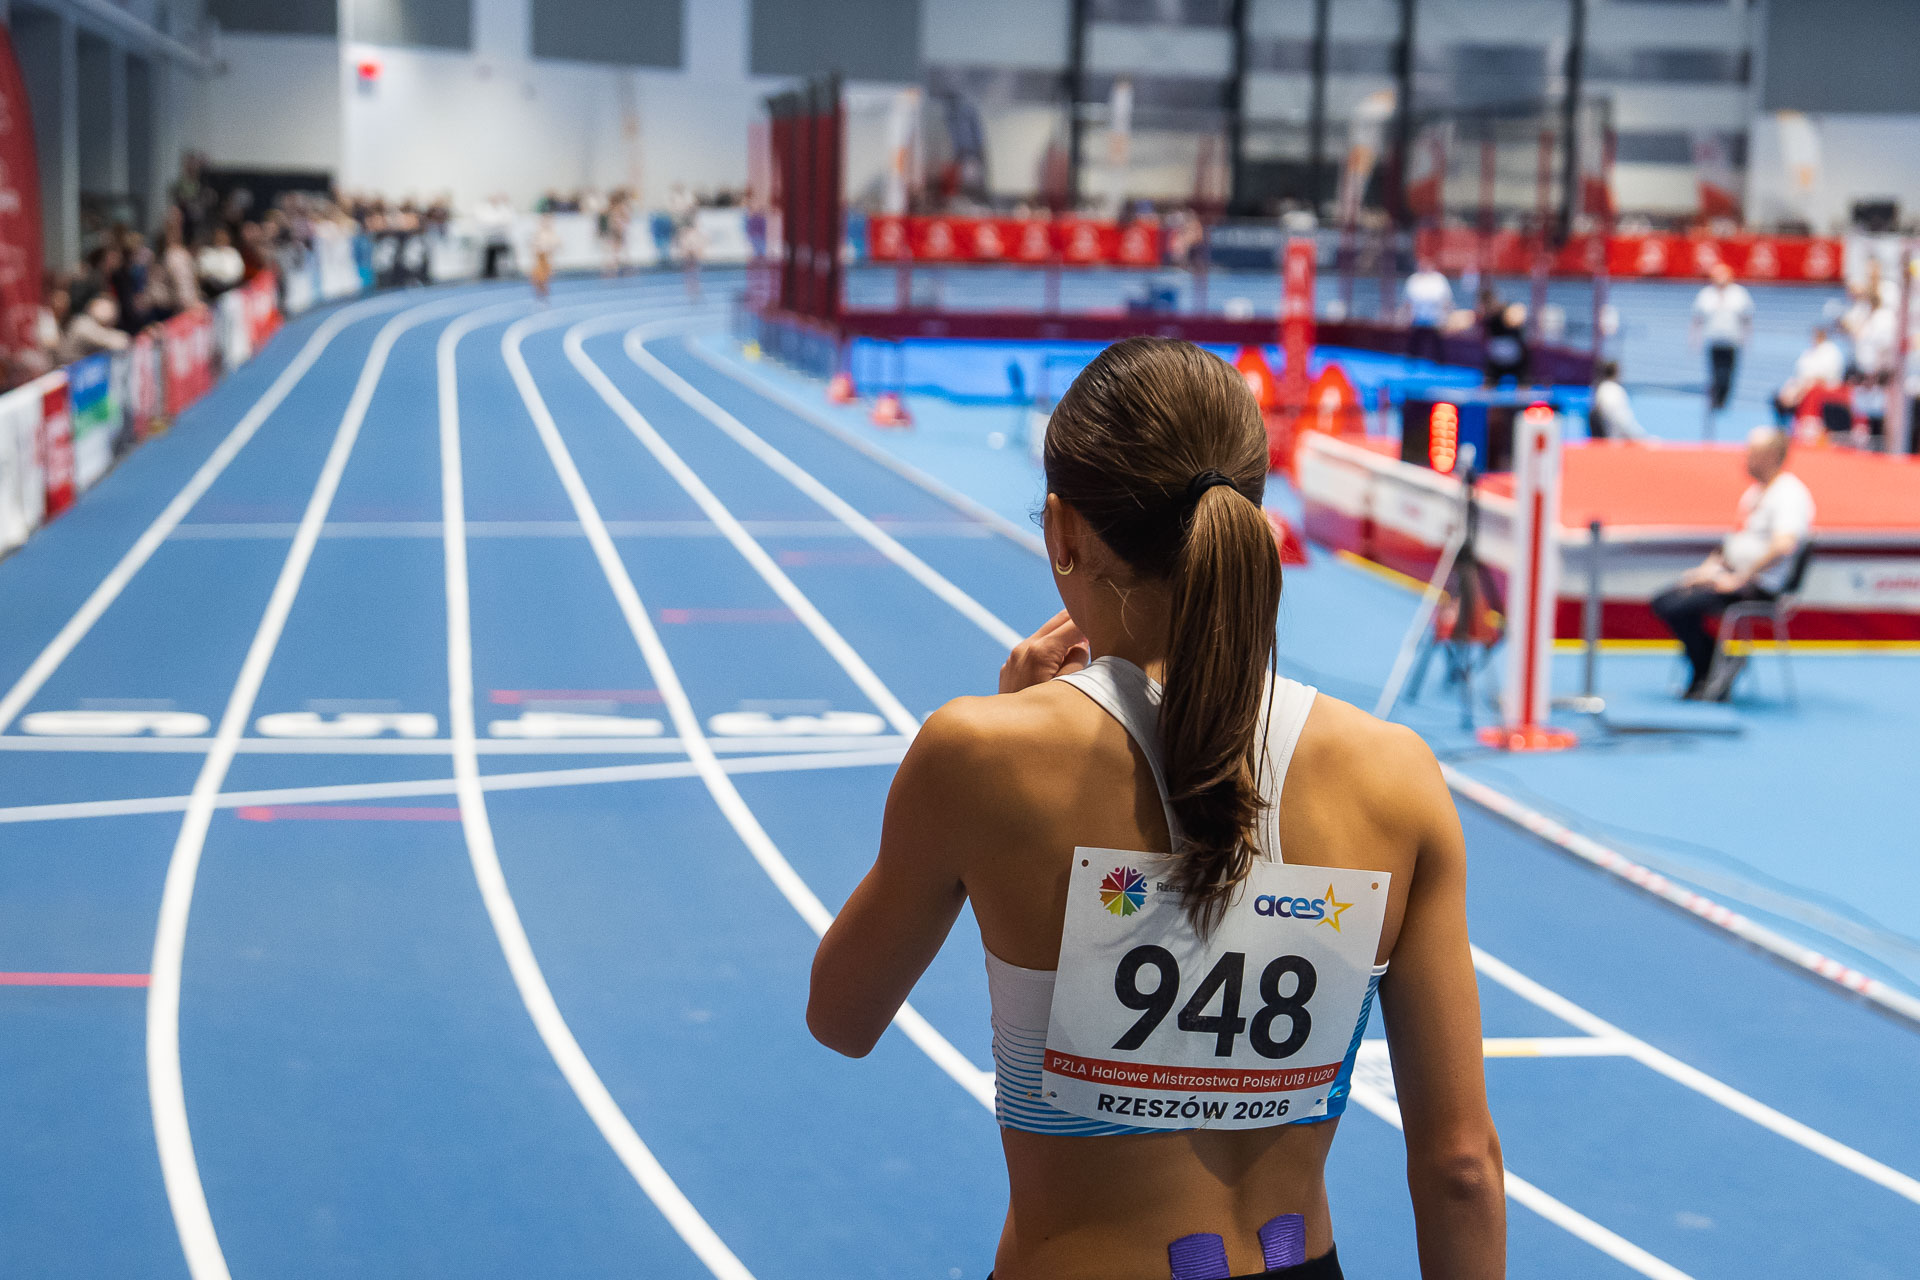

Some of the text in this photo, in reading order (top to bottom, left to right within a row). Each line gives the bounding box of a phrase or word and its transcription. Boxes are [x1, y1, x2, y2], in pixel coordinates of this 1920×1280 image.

[1254, 894, 1326, 920] aces
[1110, 944, 1318, 1060] 948
[1053, 1057, 1335, 1088] PZLA Halowe Mistrzostwa Polski U18 i U20
[1097, 1093, 1290, 1120] RZESZÓW 2026
